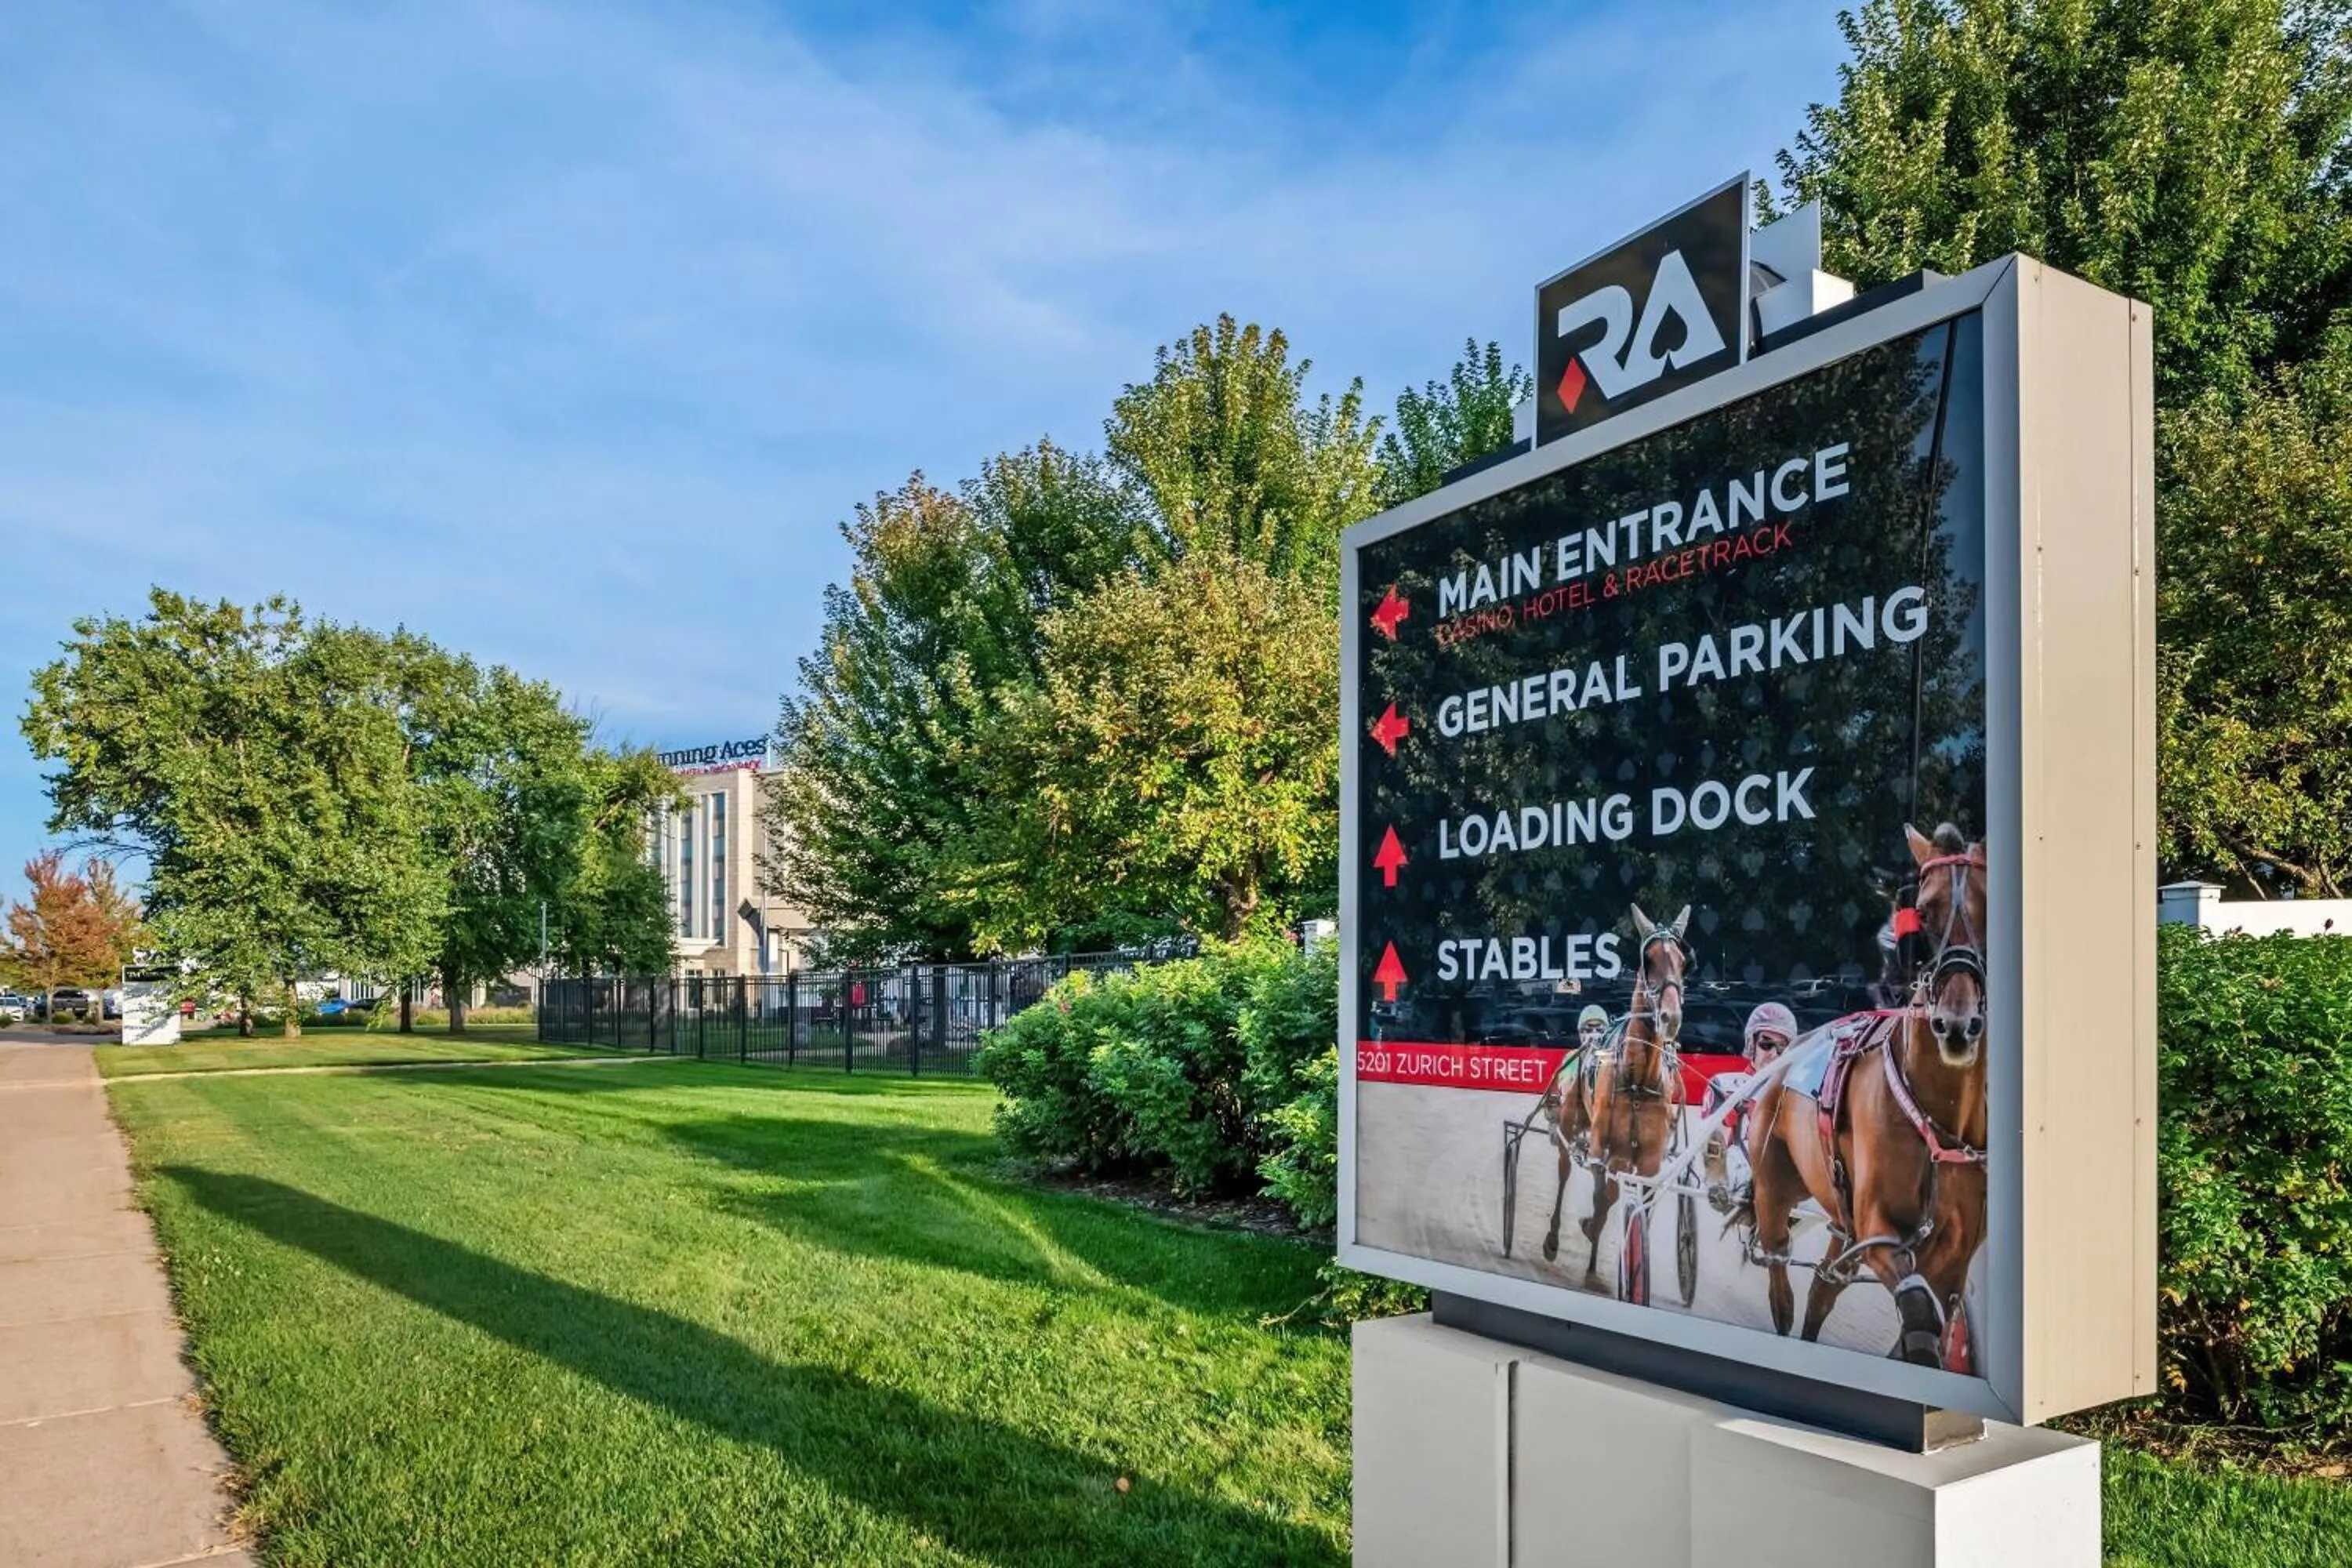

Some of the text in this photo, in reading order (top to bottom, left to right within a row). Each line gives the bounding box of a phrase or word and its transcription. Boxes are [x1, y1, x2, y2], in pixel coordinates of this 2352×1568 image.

[1557, 249, 1726, 414] RA
[1439, 442, 1850, 618] MAIN ENTRANCE
[1523, 583, 1595, 622] HOTEL
[1602, 572, 1621, 598] &
[1626, 522, 1793, 592] RACETRACK
[1437, 586, 1928, 739] GENERAL PARKING
[720, 739, 767, 759] Aces
[1439, 767, 1815, 858] LOADING DOCK
[1437, 932, 1621, 981] STABLES
[1357, 1051, 1548, 1083] 5201 ZURICH STREET
